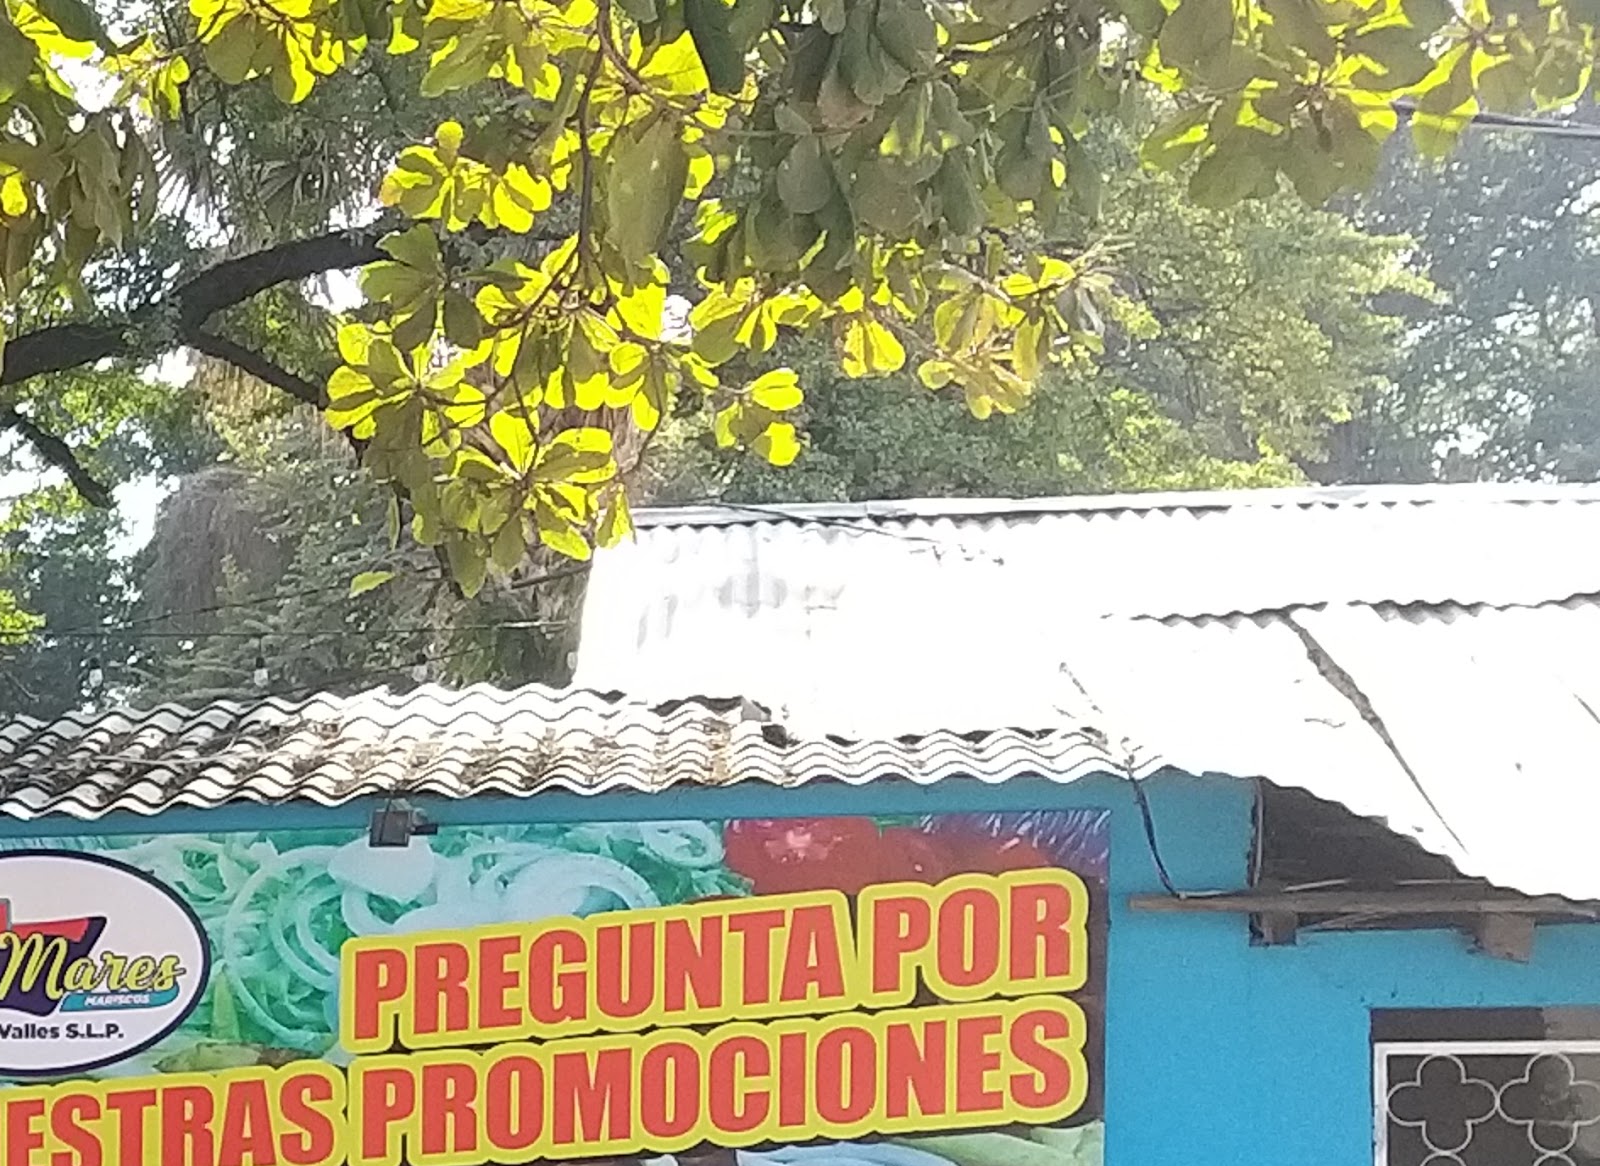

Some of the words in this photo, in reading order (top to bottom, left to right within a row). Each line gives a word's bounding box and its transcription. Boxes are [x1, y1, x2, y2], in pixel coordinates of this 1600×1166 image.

[65, 1022, 125, 1040] S.L.P.
[353, 904, 846, 1040] PREGUNTA
[872, 882, 1072, 993] POR
[362, 1010, 1072, 1160] PROMOCIONES
